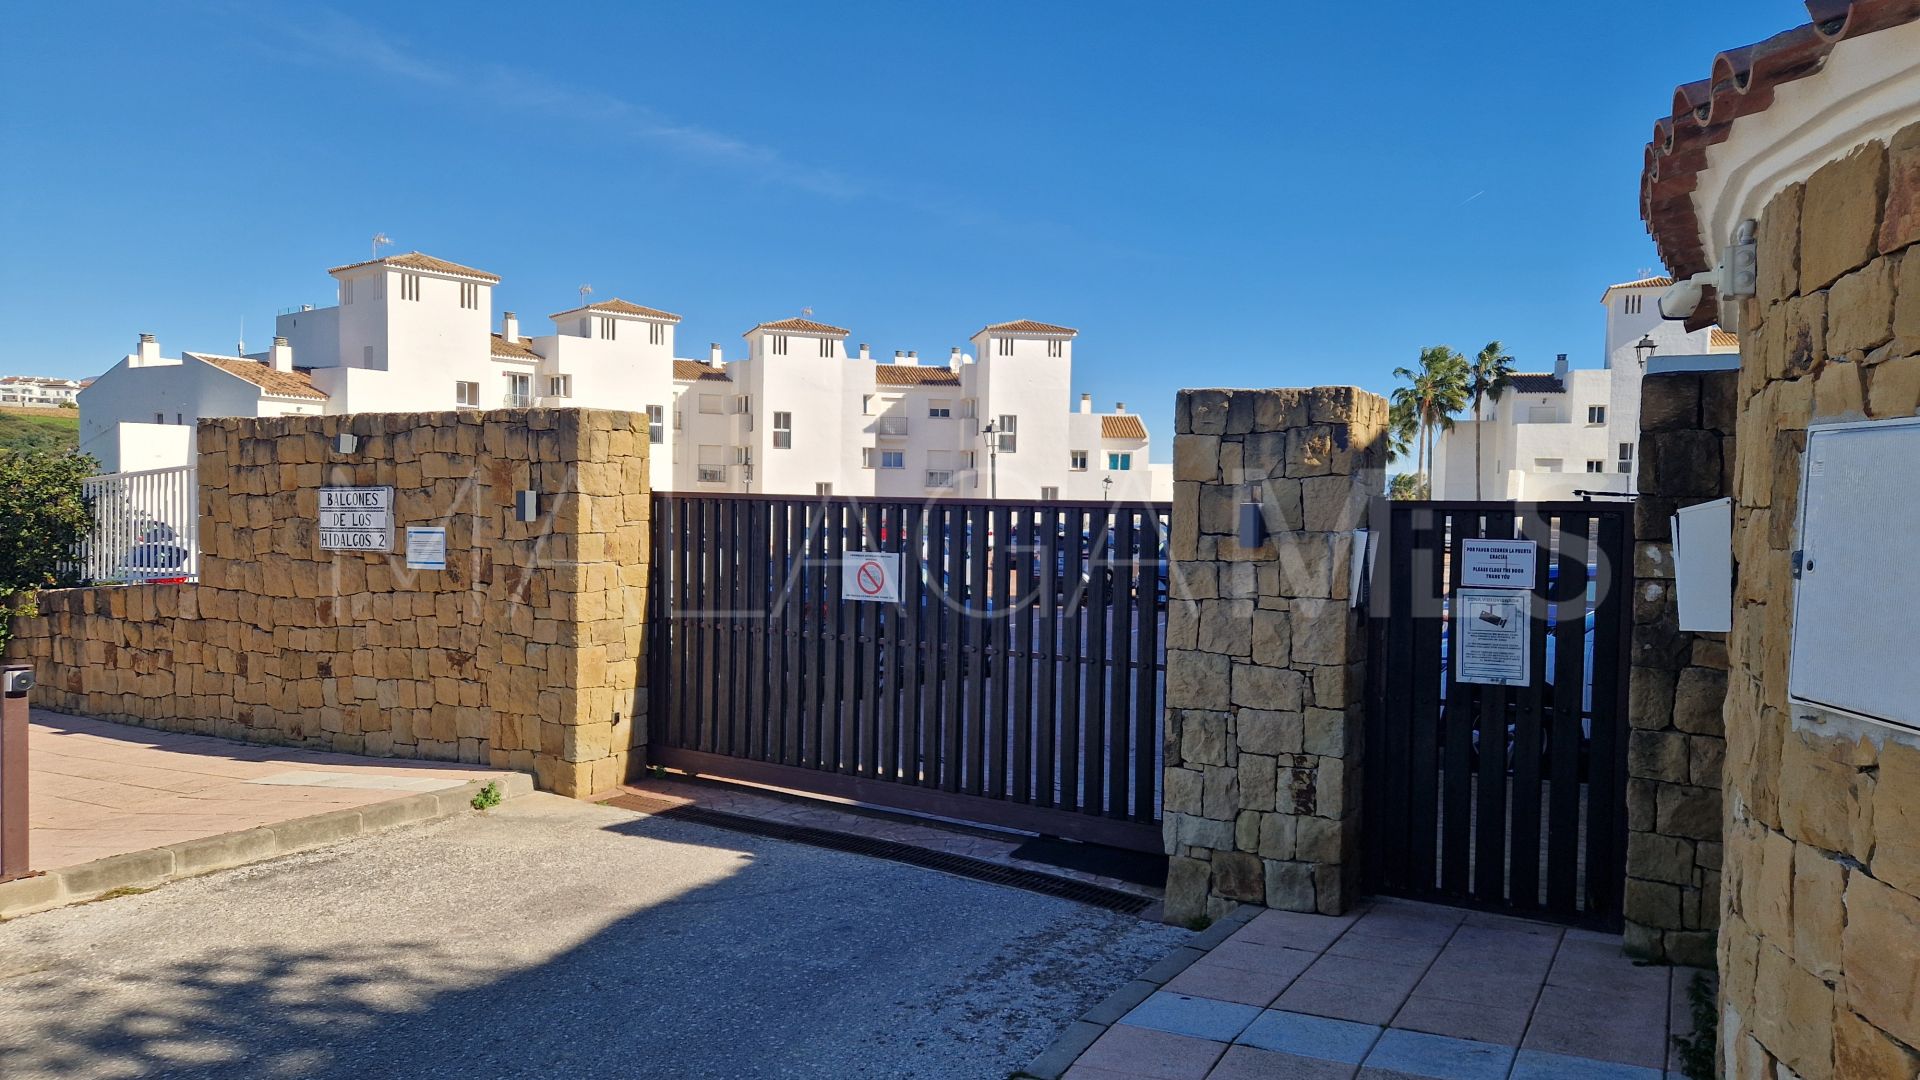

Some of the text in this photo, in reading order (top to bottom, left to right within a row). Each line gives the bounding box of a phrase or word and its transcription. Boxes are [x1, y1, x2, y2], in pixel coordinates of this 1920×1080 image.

[327, 492, 379, 506] BALCONES
[333, 513, 372, 527] DE LOS
[321, 533, 385, 547] HIDALGOS 2
